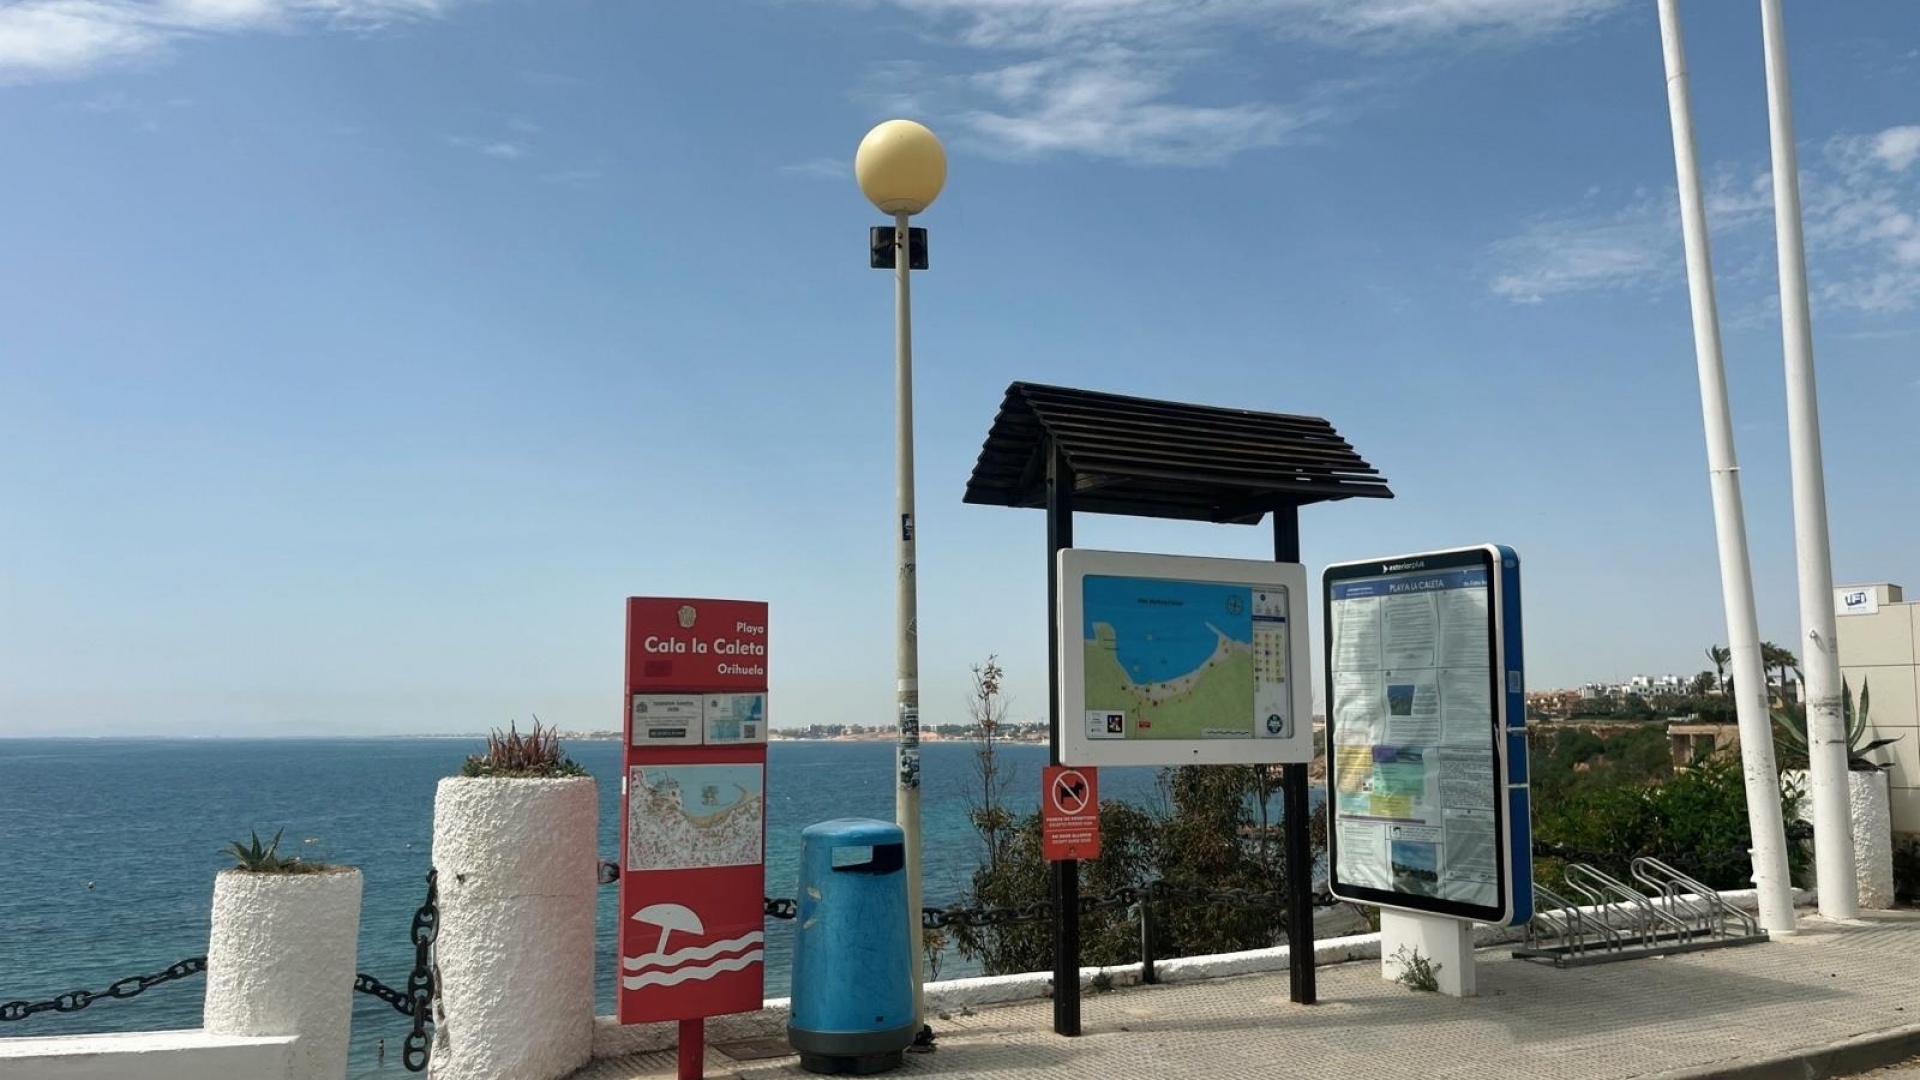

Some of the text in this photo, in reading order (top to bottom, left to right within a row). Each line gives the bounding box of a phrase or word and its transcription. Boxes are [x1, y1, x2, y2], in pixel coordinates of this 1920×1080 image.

[1388, 582, 1410, 593] PLAYA
[1418, 579, 1445, 590] CALETA
[736, 622, 764, 635] Playa
[644, 636, 764, 655] Cala la Caleta
[717, 663, 764, 675] Orihuela
